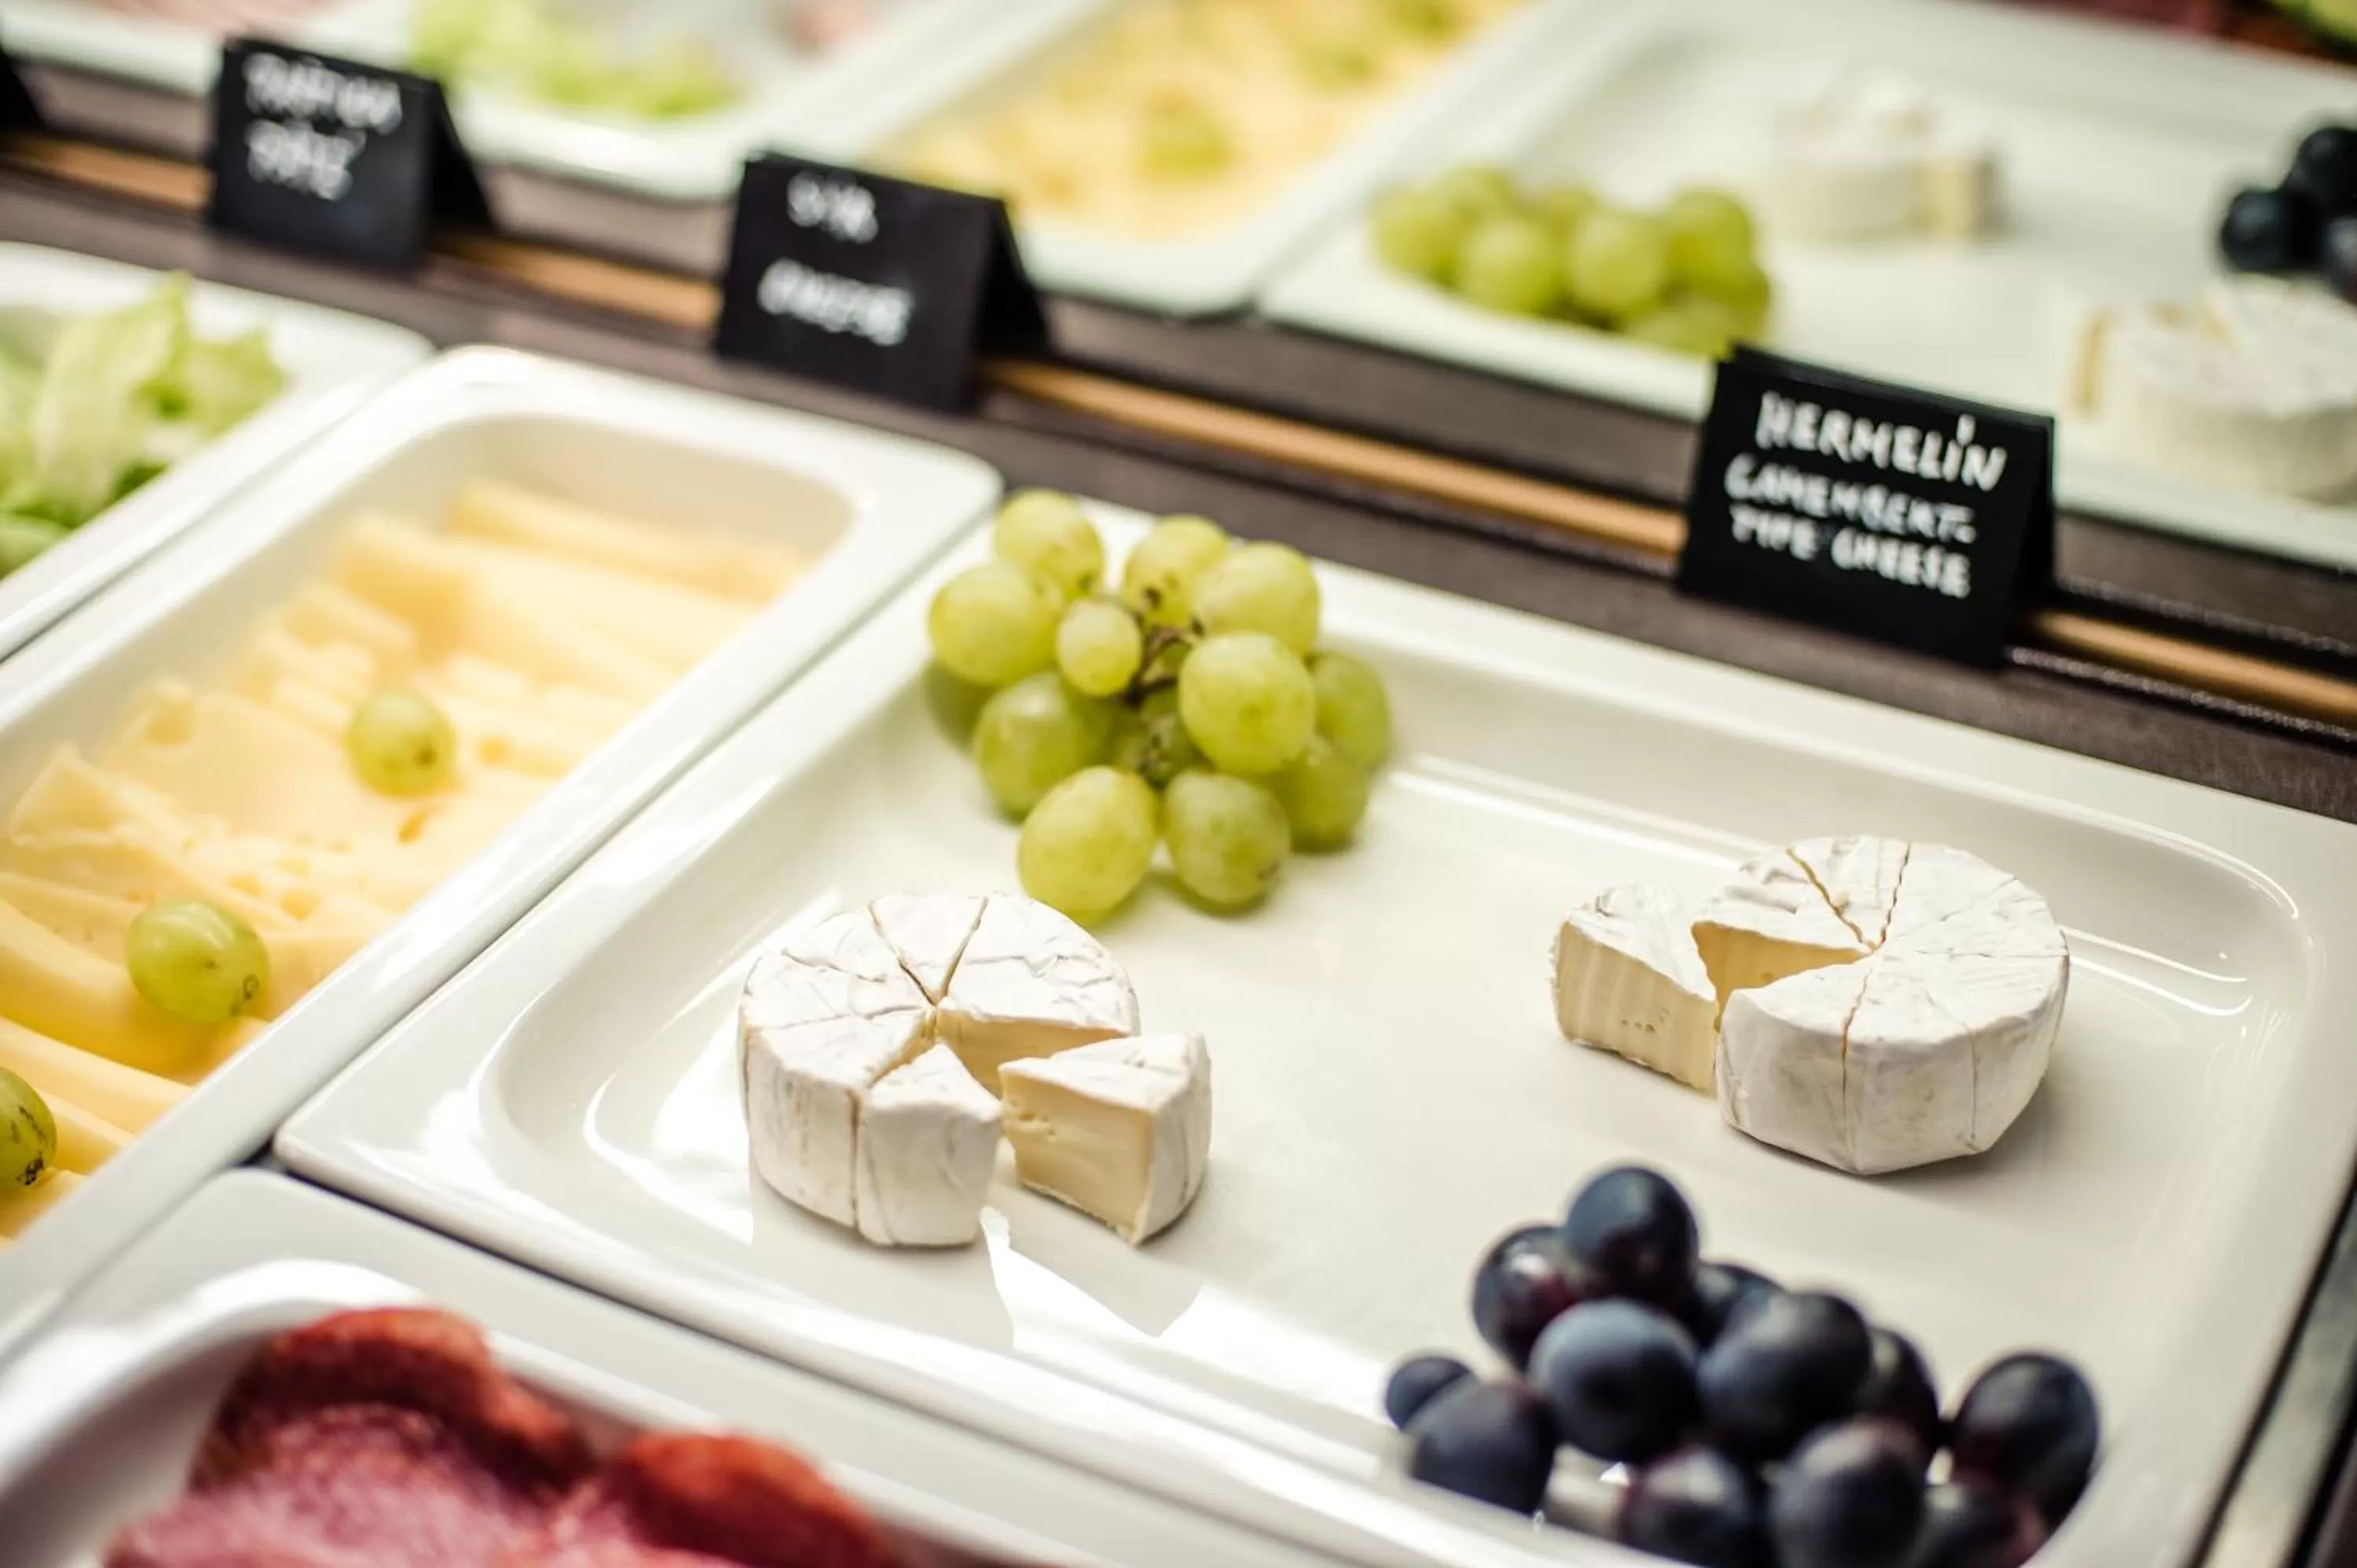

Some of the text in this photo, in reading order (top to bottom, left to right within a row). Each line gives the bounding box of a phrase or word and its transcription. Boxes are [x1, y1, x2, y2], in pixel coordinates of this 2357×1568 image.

[1756, 391, 2007, 491] HERMELÍN
[1730, 503, 1970, 598] TYPE CHEESE
